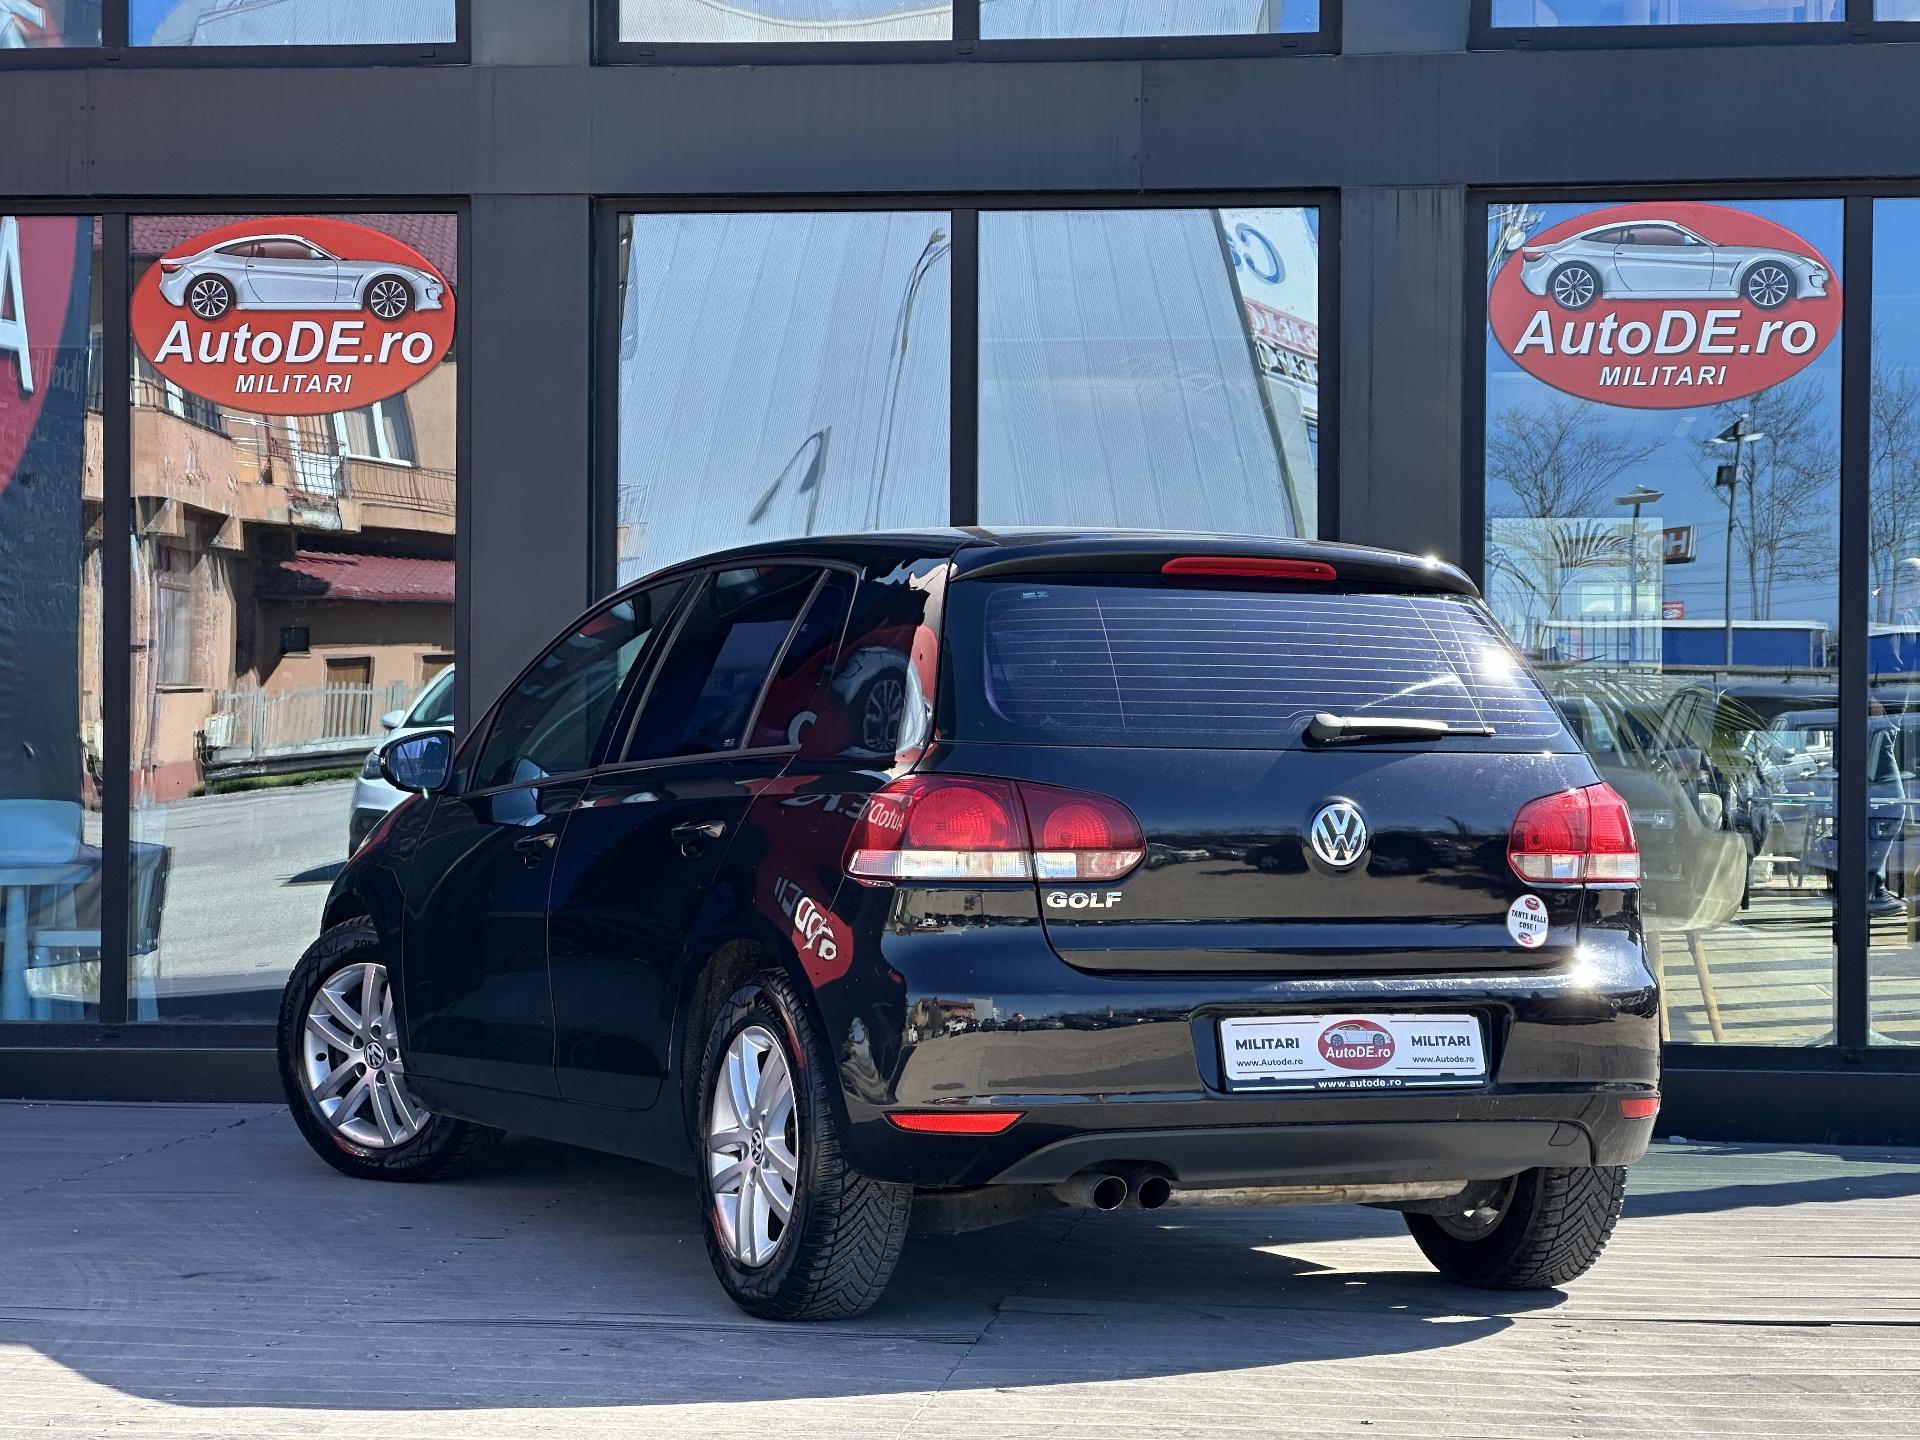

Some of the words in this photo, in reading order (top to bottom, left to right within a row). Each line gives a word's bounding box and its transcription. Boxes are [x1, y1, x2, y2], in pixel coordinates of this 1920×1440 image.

[1513, 310, 1818, 356] AutoDE.ro
[154, 320, 435, 366] AutoDE.ro
[1598, 365, 1728, 387] MILITARI
[234, 373, 353, 395] MILITARI
[1046, 891, 1123, 909] GOLF
[1511, 910, 1529, 920] TANTE
[1235, 1037, 1300, 1050] MILITARI
[1411, 1035, 1471, 1047] MILITARI
[1325, 1045, 1391, 1059] AutoDE.ro
[1236, 1058, 1304, 1067] www.Autode.ro
[1412, 1055, 1475, 1064] www.Autode.ro
[1318, 1077, 1402, 1089] www.autode.ro
